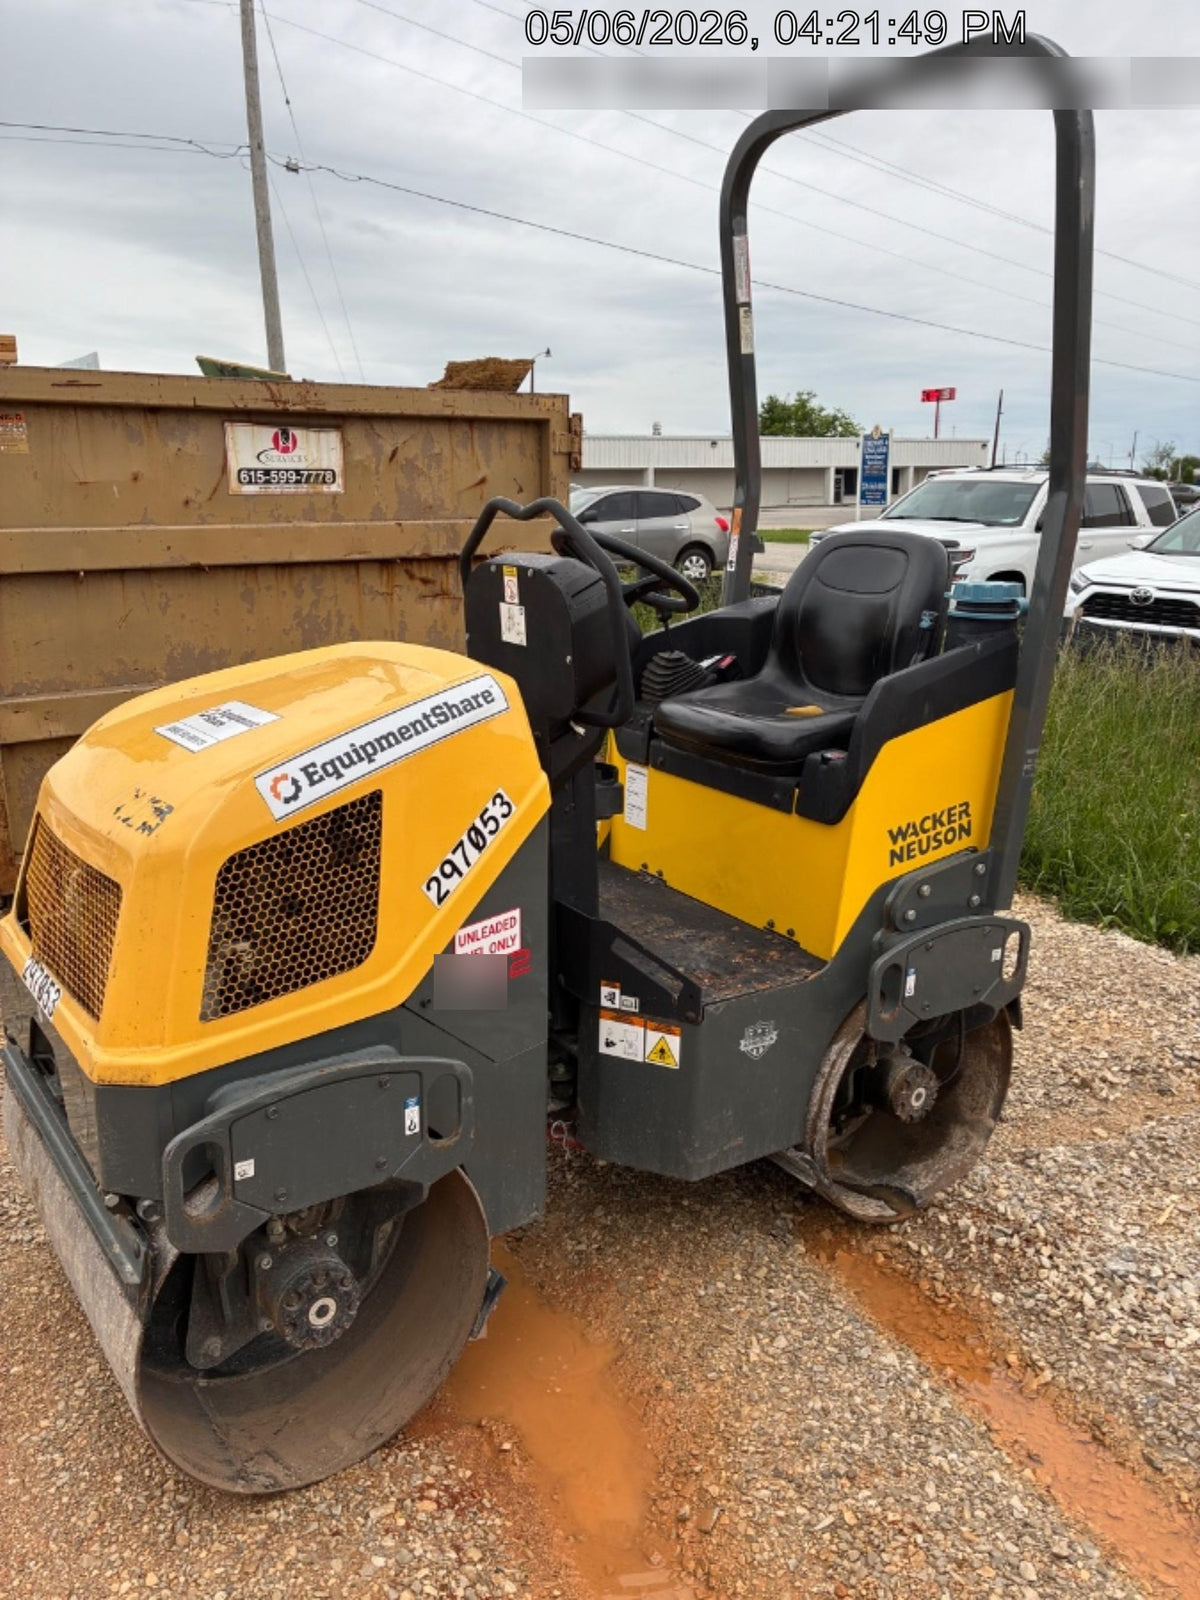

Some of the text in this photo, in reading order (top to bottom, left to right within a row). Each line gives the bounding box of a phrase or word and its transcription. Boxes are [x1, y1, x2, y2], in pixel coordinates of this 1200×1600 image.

[239, 470, 334, 483] 615-599-7778
[299, 688, 495, 787] EquipmentShare
[887, 801, 972, 846] WACKER
[889, 819, 972, 868] NEUSON
[425, 792, 513, 906] 297053
[457, 916, 518, 948] UNLEADED
[489, 933, 518, 954] ONLY
